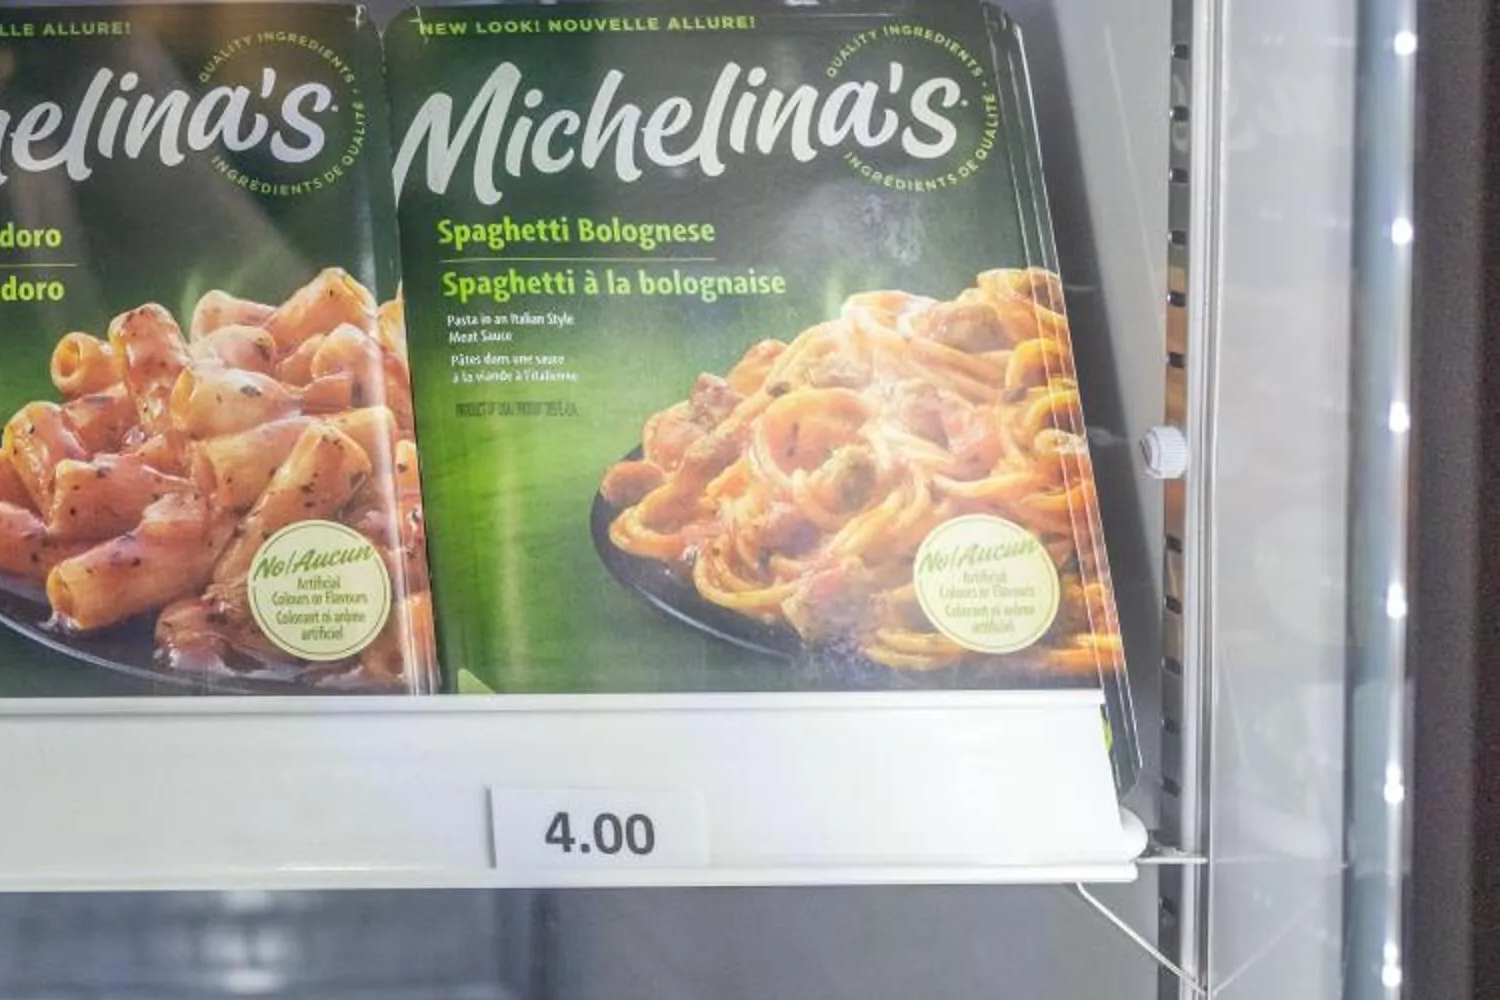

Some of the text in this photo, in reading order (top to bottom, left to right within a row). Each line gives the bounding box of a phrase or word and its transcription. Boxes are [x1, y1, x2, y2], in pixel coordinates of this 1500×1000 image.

[43, 21, 133, 37] ALLURE!
[419, 15, 757, 35] NEW LOOK! NOUVELLE ALLURE!
[199, 31, 356, 84] QUALITY INGREDIENTS
[826, 25, 984, 78] QUALITY INGREDIENTS
[392, 61, 960, 206] Michelina's
[324, 166, 344, 183] DE
[958, 160, 978, 177] DE
[436, 216, 716, 250] Spaghetti Bolognese
[443, 268, 786, 303] Spaghetti à la bolognaise
[447, 312, 575, 328] Pasta in an Italian Style
[449, 331, 478, 343] Meat
[545, 811, 656, 856] 4.00
